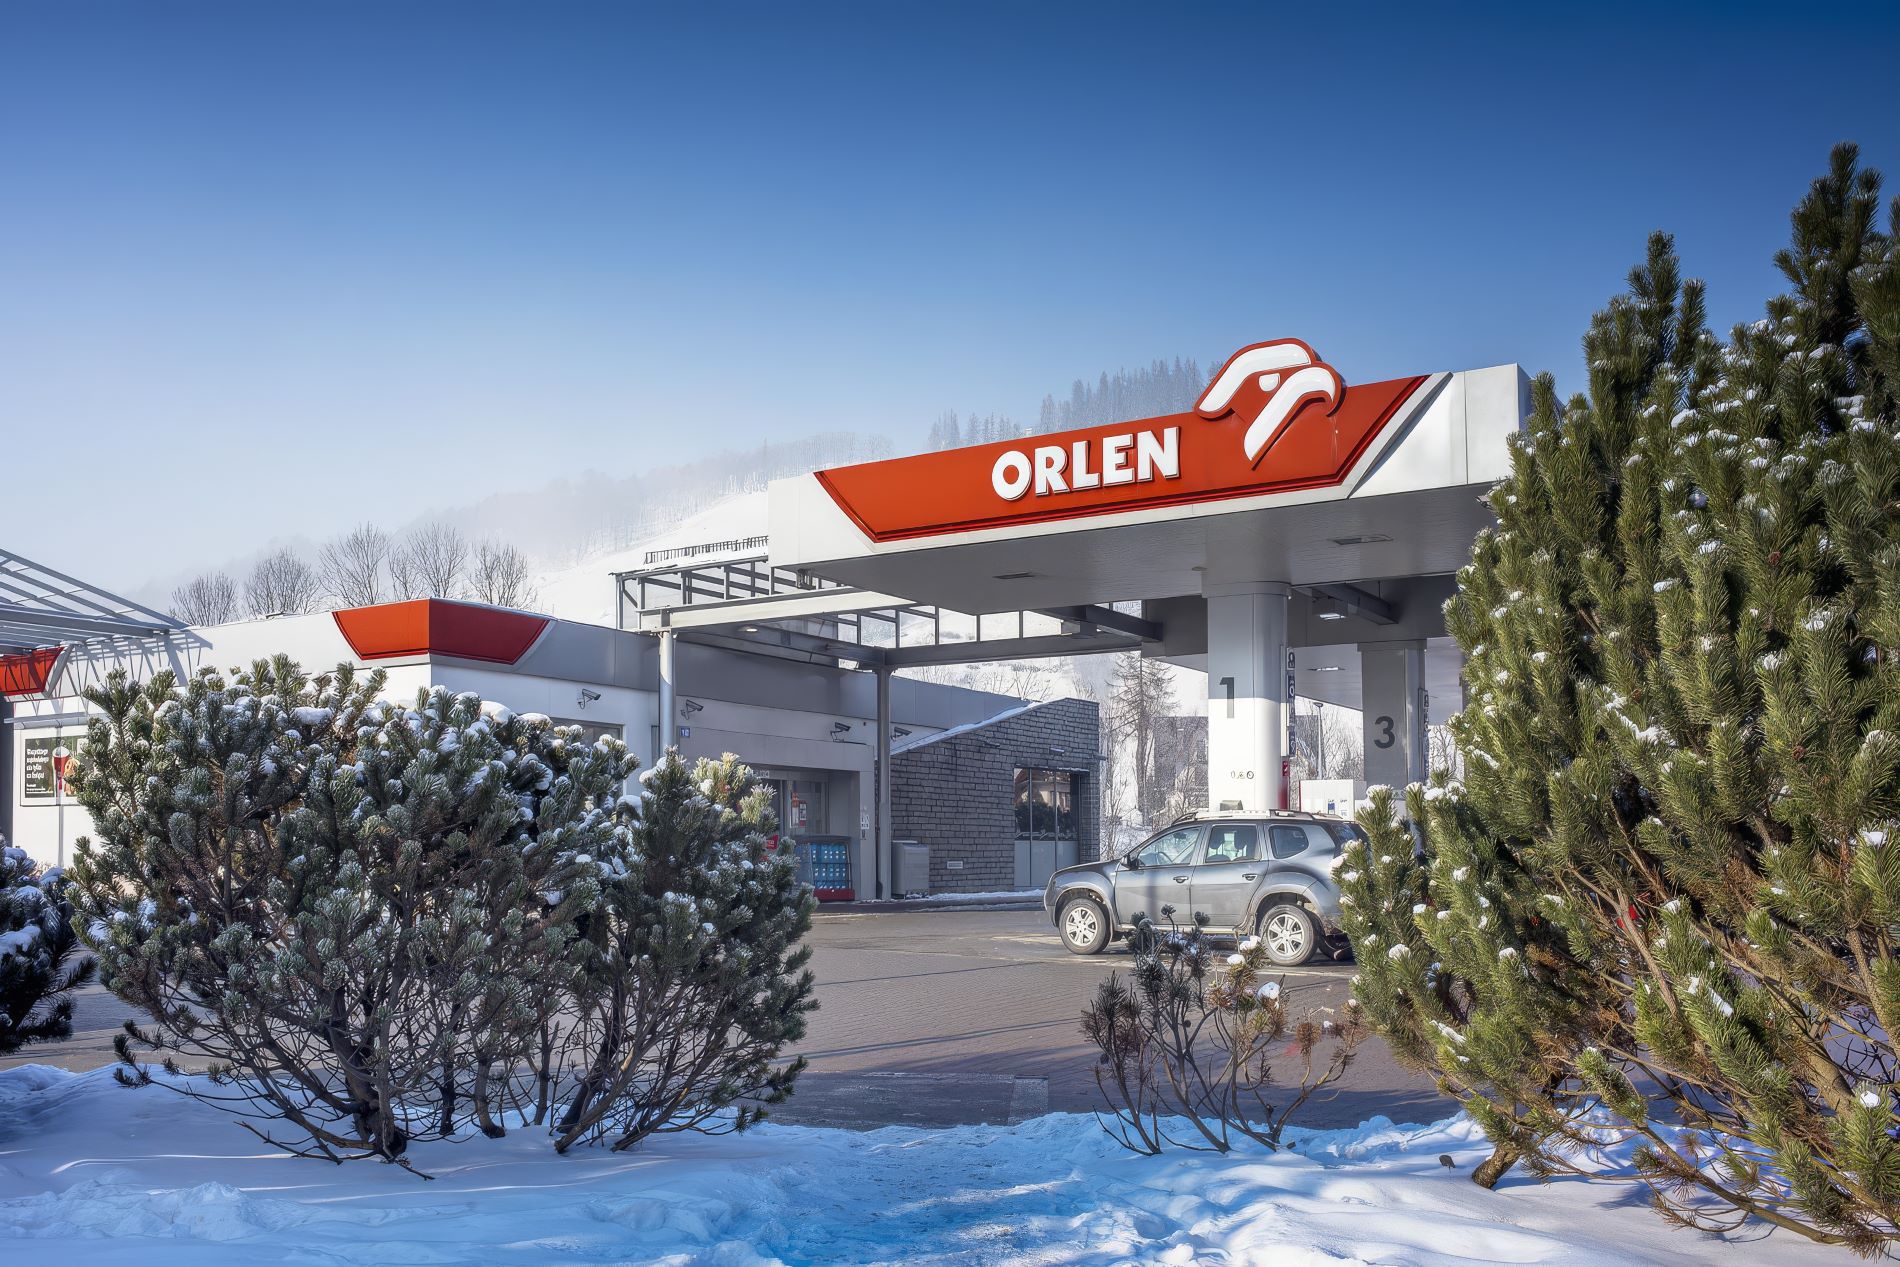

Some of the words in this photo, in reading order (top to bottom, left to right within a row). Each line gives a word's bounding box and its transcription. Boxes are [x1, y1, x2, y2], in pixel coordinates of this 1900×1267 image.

[991, 426, 1180, 501] ORLEN
[1219, 676, 1235, 718] 1
[1373, 715, 1396, 749] 3
